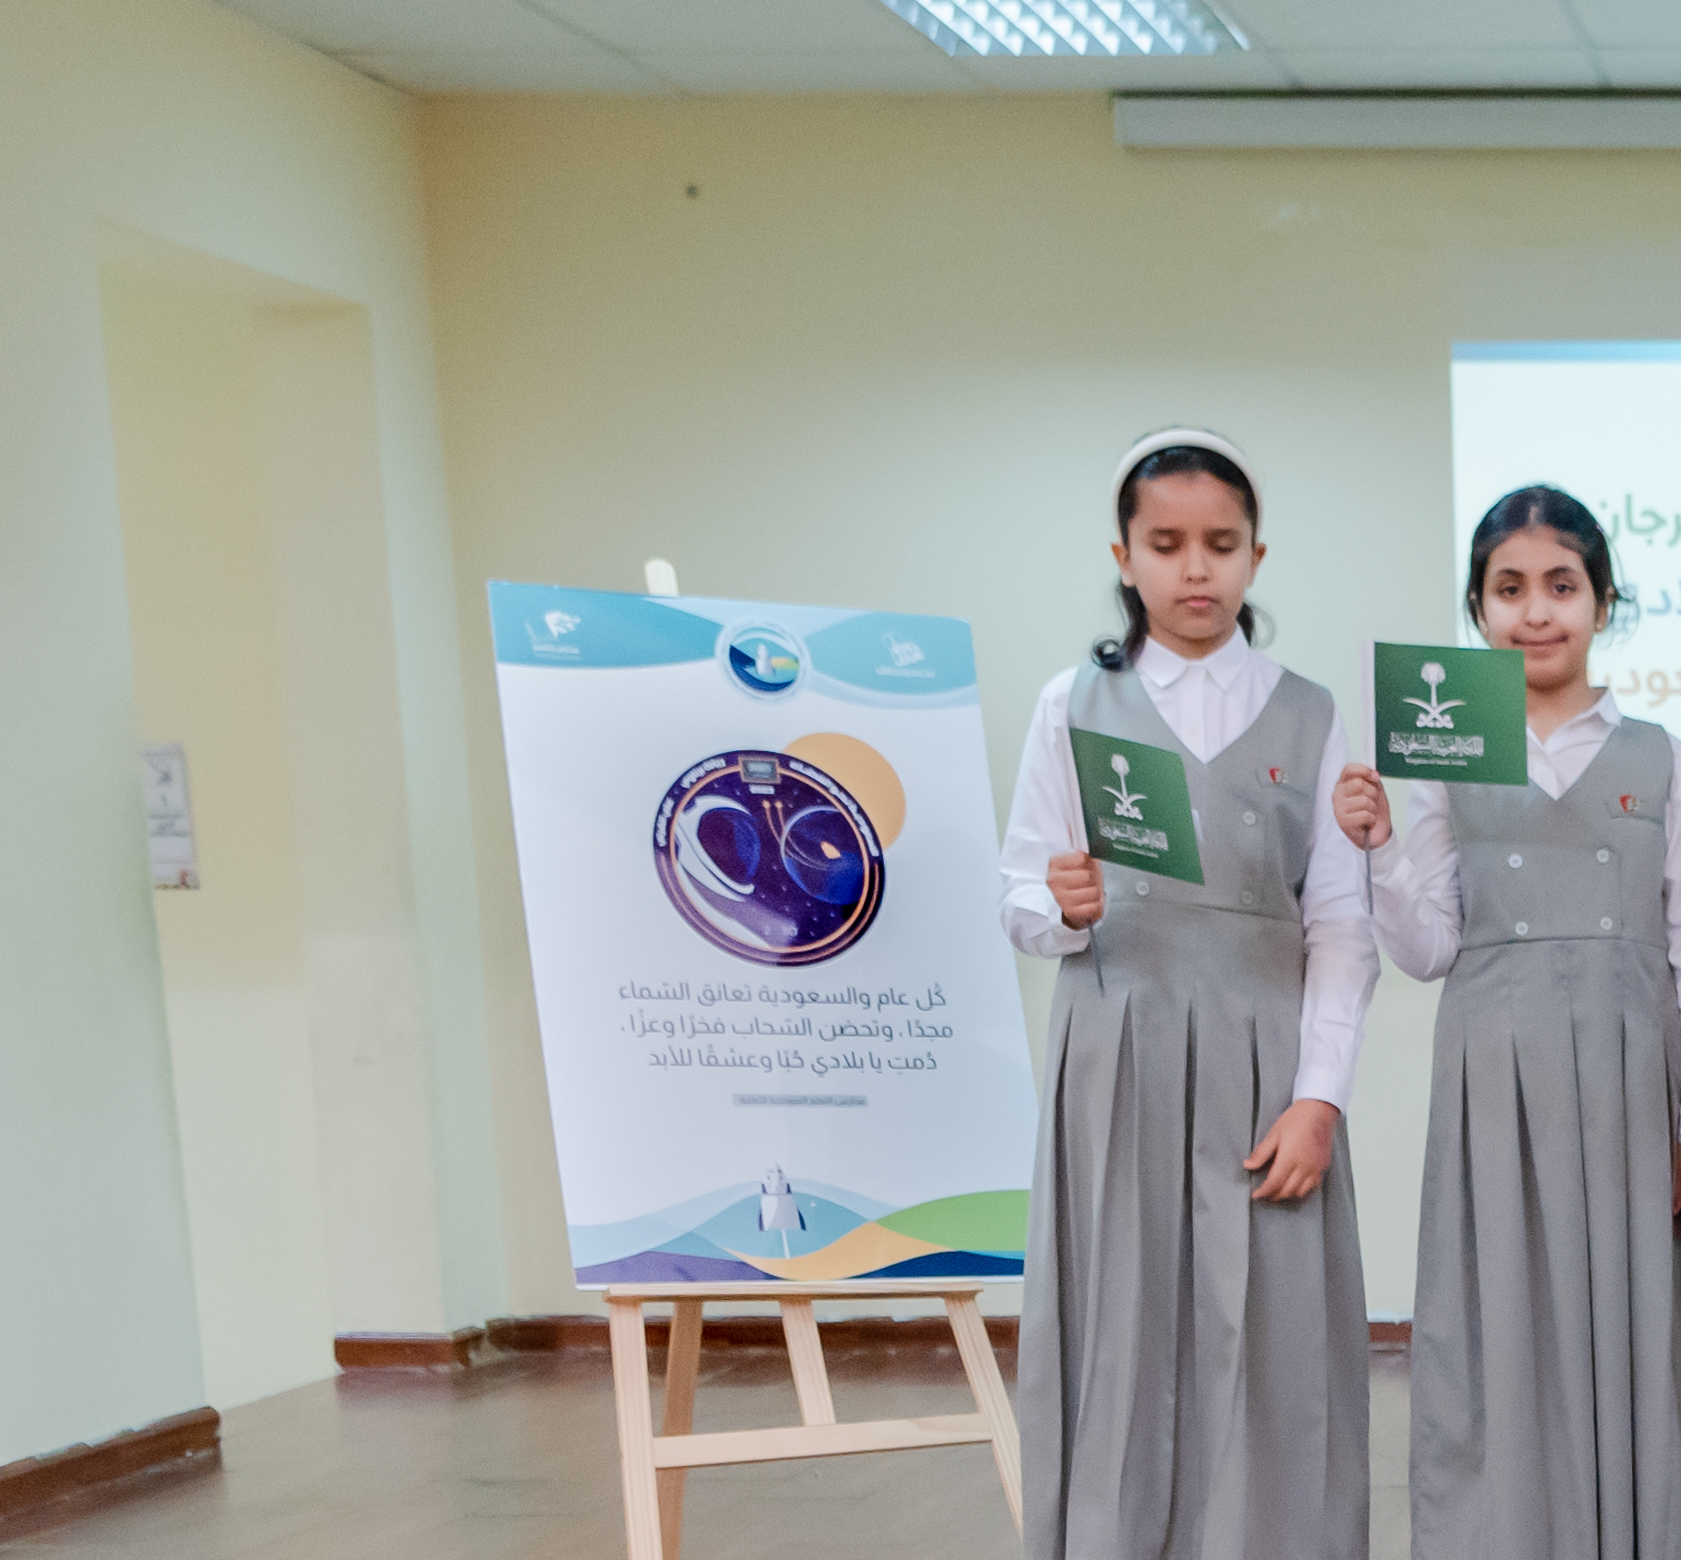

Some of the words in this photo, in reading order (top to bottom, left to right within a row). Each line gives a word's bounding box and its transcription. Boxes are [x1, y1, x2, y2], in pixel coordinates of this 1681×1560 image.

[697, 983, 752, 1007] تعانق
[758, 984, 871, 1010] والسعودية
[877, 986, 910, 1013] عام
[818, 1019, 894, 1043] وتحضن
[649, 1044, 692, 1071] للأبد
[811, 1051, 865, 1078] بلادي
[868, 1051, 882, 1074] يا
